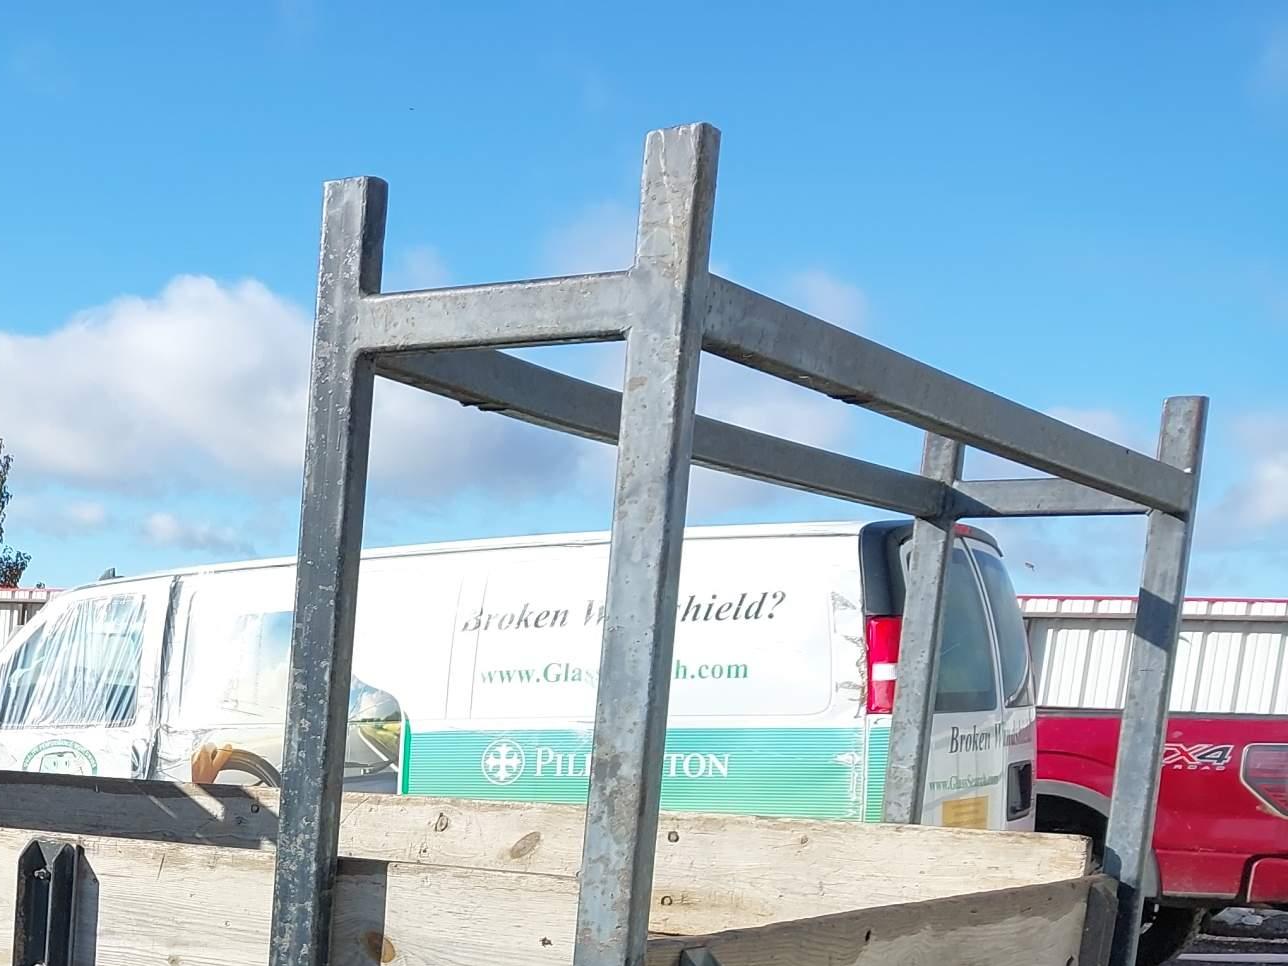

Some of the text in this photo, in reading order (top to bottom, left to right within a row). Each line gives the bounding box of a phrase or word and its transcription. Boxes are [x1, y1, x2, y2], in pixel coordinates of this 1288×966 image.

[462, 603, 569, 632] Broken
[948, 725, 991, 754] Broken
[534, 746, 731, 779] PILTON
